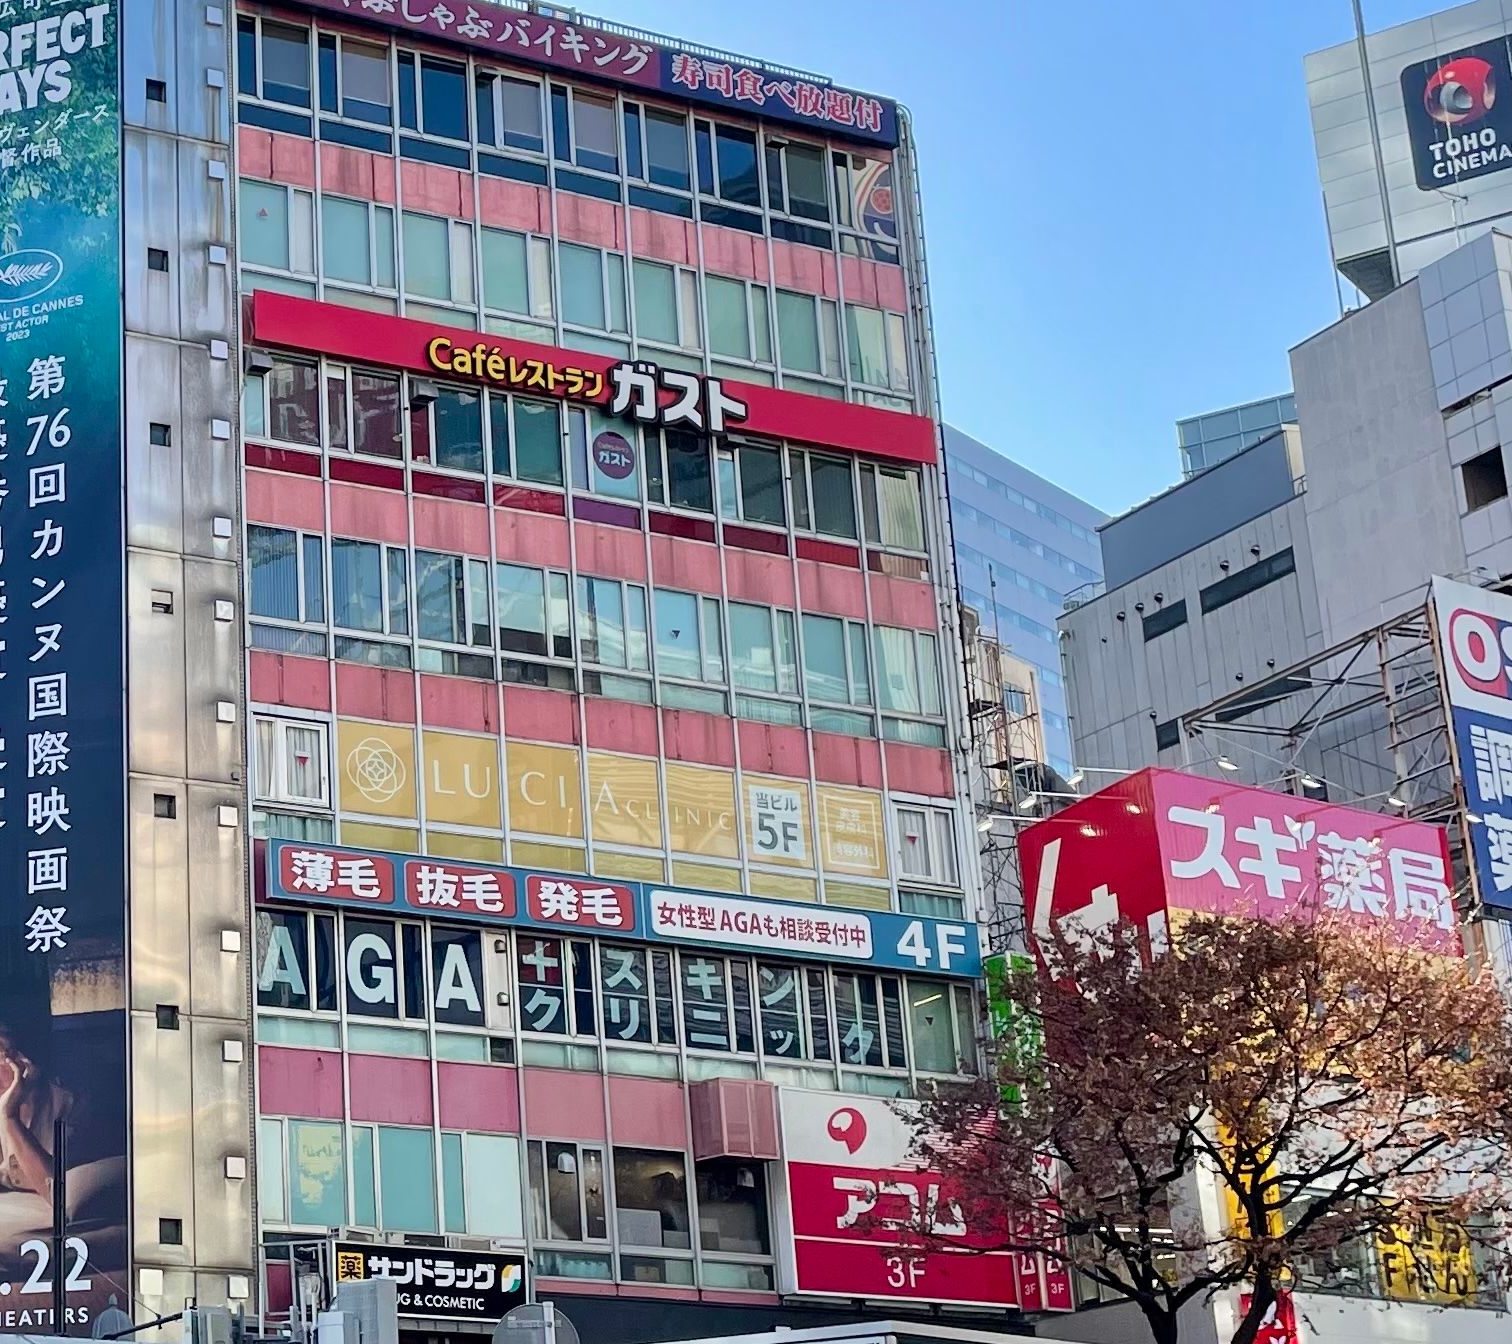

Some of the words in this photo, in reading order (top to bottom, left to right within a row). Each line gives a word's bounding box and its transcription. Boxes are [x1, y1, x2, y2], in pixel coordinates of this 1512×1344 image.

[671, 53, 884, 132] 寿司食べ放題付
[1429, 127, 1497, 162] TOHO
[13, 305, 29, 319] DE
[32, 294, 84, 315] CANNES
[14, 314, 49, 330] ACTOR
[5, 328, 31, 342] 2023
[612, 363, 747, 432] ガスト
[597, 450, 632, 467] ガスト
[25, 355, 72, 954] 第76回カンヌ国際映画祭
[433, 759, 620, 816] LUCIA
[625, 798, 733, 831] CLINIC
[755, 791, 798, 813] 当ビル
[757, 813, 800, 853] 5F
[1168, 805, 1458, 932] スギ薬局
[291, 851, 381, 898] 薄毛
[416, 865, 505, 913] 抜毛
[538, 880, 624, 926] 発毛
[896, 919, 967, 971] 4F
[258, 925, 482, 1013] AGA
[367, 1255, 497, 1290] サンドラッグ
[887, 1257, 926, 1288] 3F
[1024, 1284, 1037, 1296] 3F
[1050, 1283, 1065, 1295] 3F
[413, 1293, 424, 1306] &
[424, 1293, 485, 1312] COSMETIC
